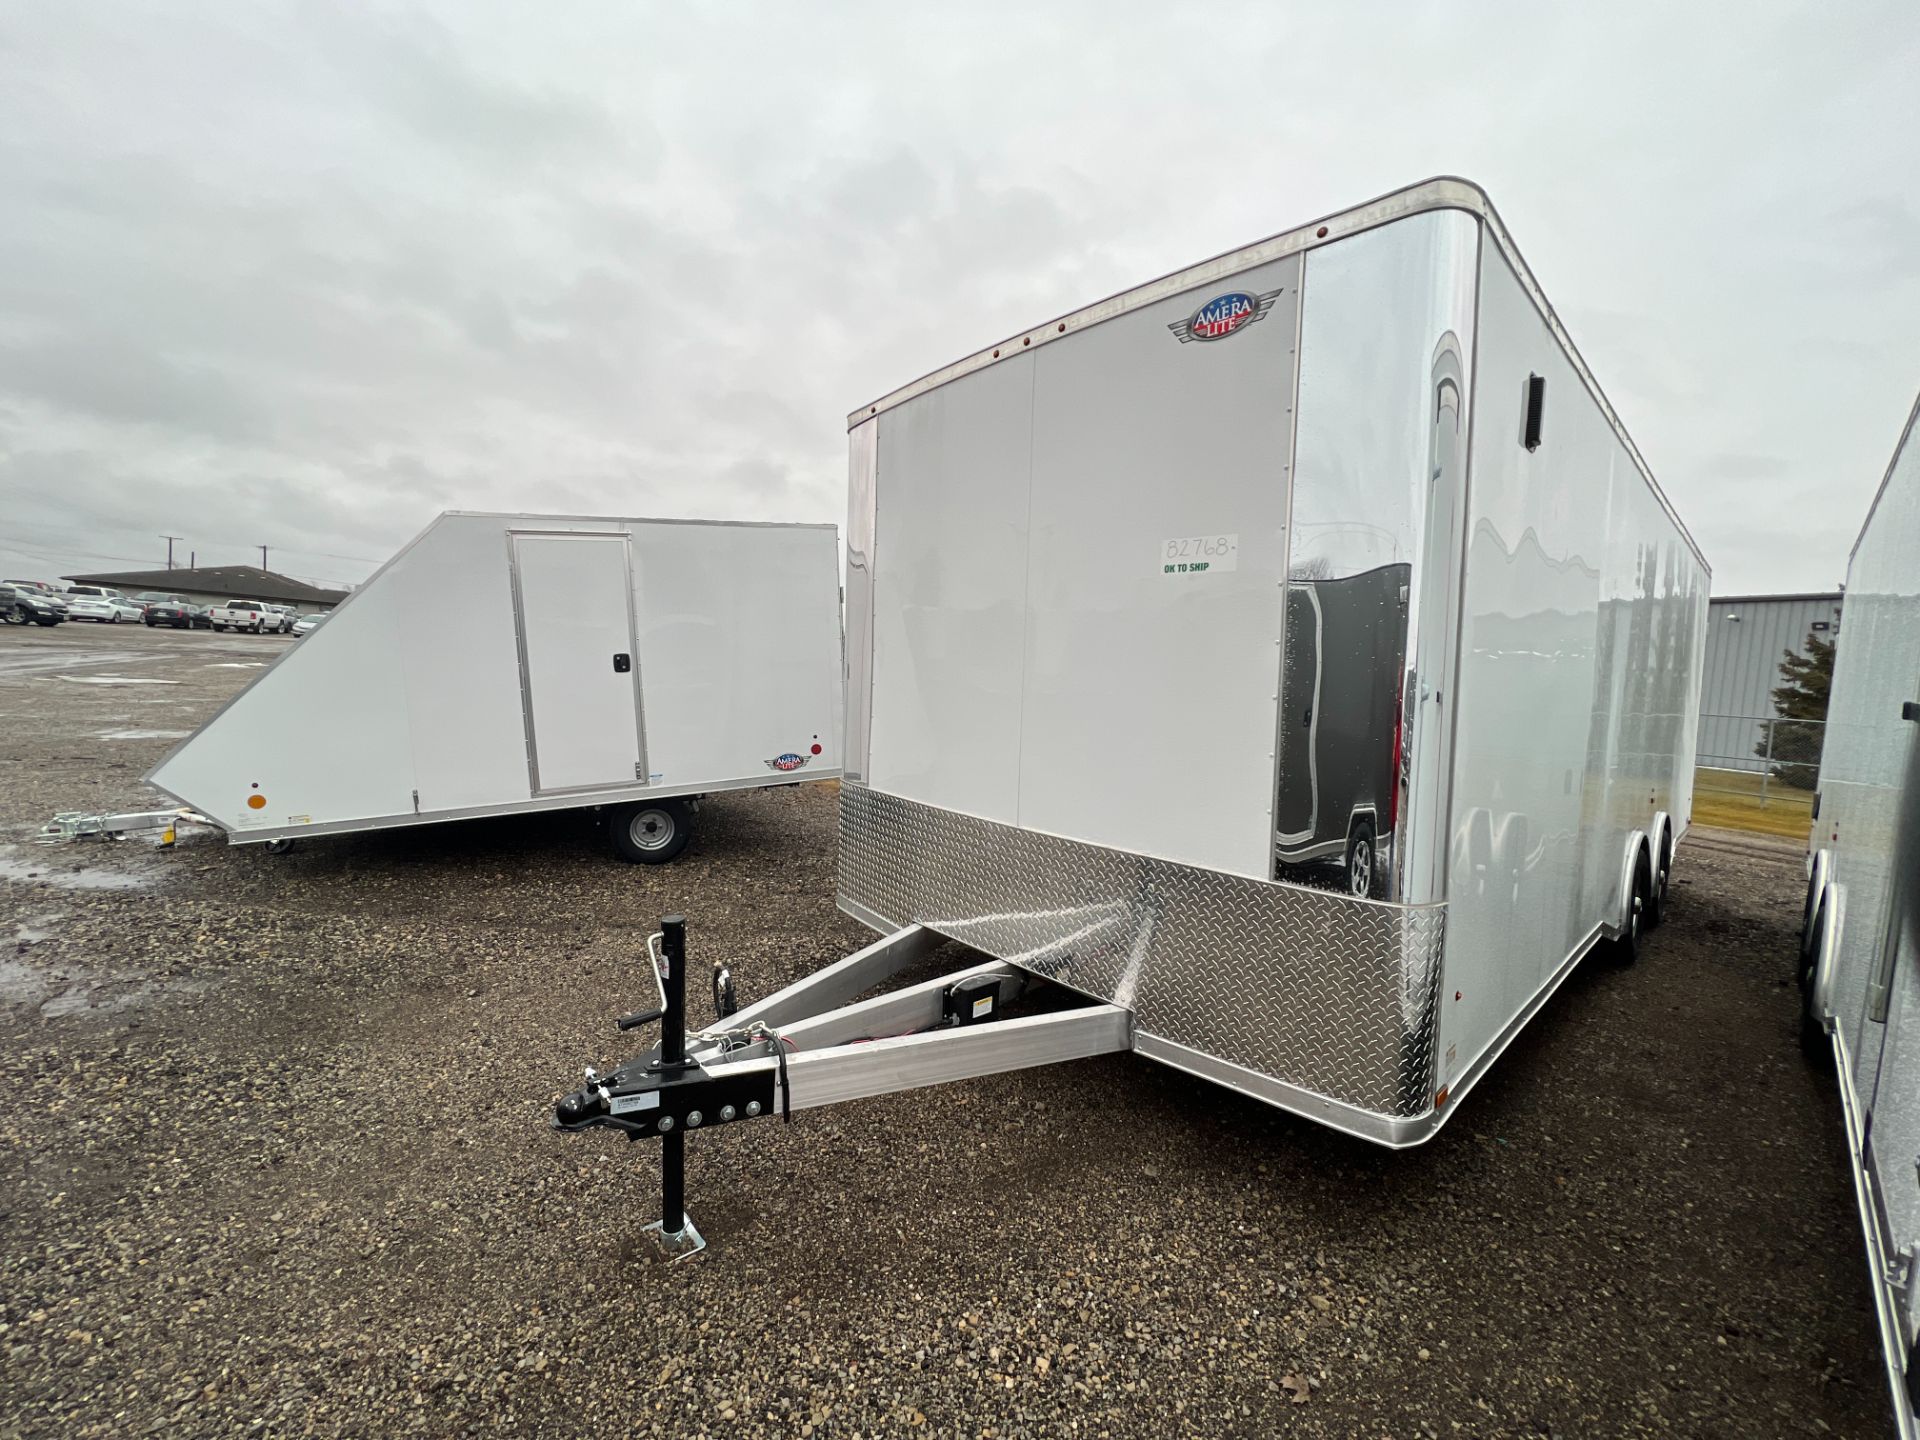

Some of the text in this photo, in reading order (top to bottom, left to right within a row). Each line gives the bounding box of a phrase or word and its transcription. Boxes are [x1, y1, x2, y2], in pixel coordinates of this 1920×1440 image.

[1195, 299, 1251, 328] AMERA
[1206, 318, 1236, 337] LITE
[1166, 537, 1229, 558] 82768
[1164, 562, 1209, 573] OK TO SHIP
[777, 756, 801, 765] AMERA
